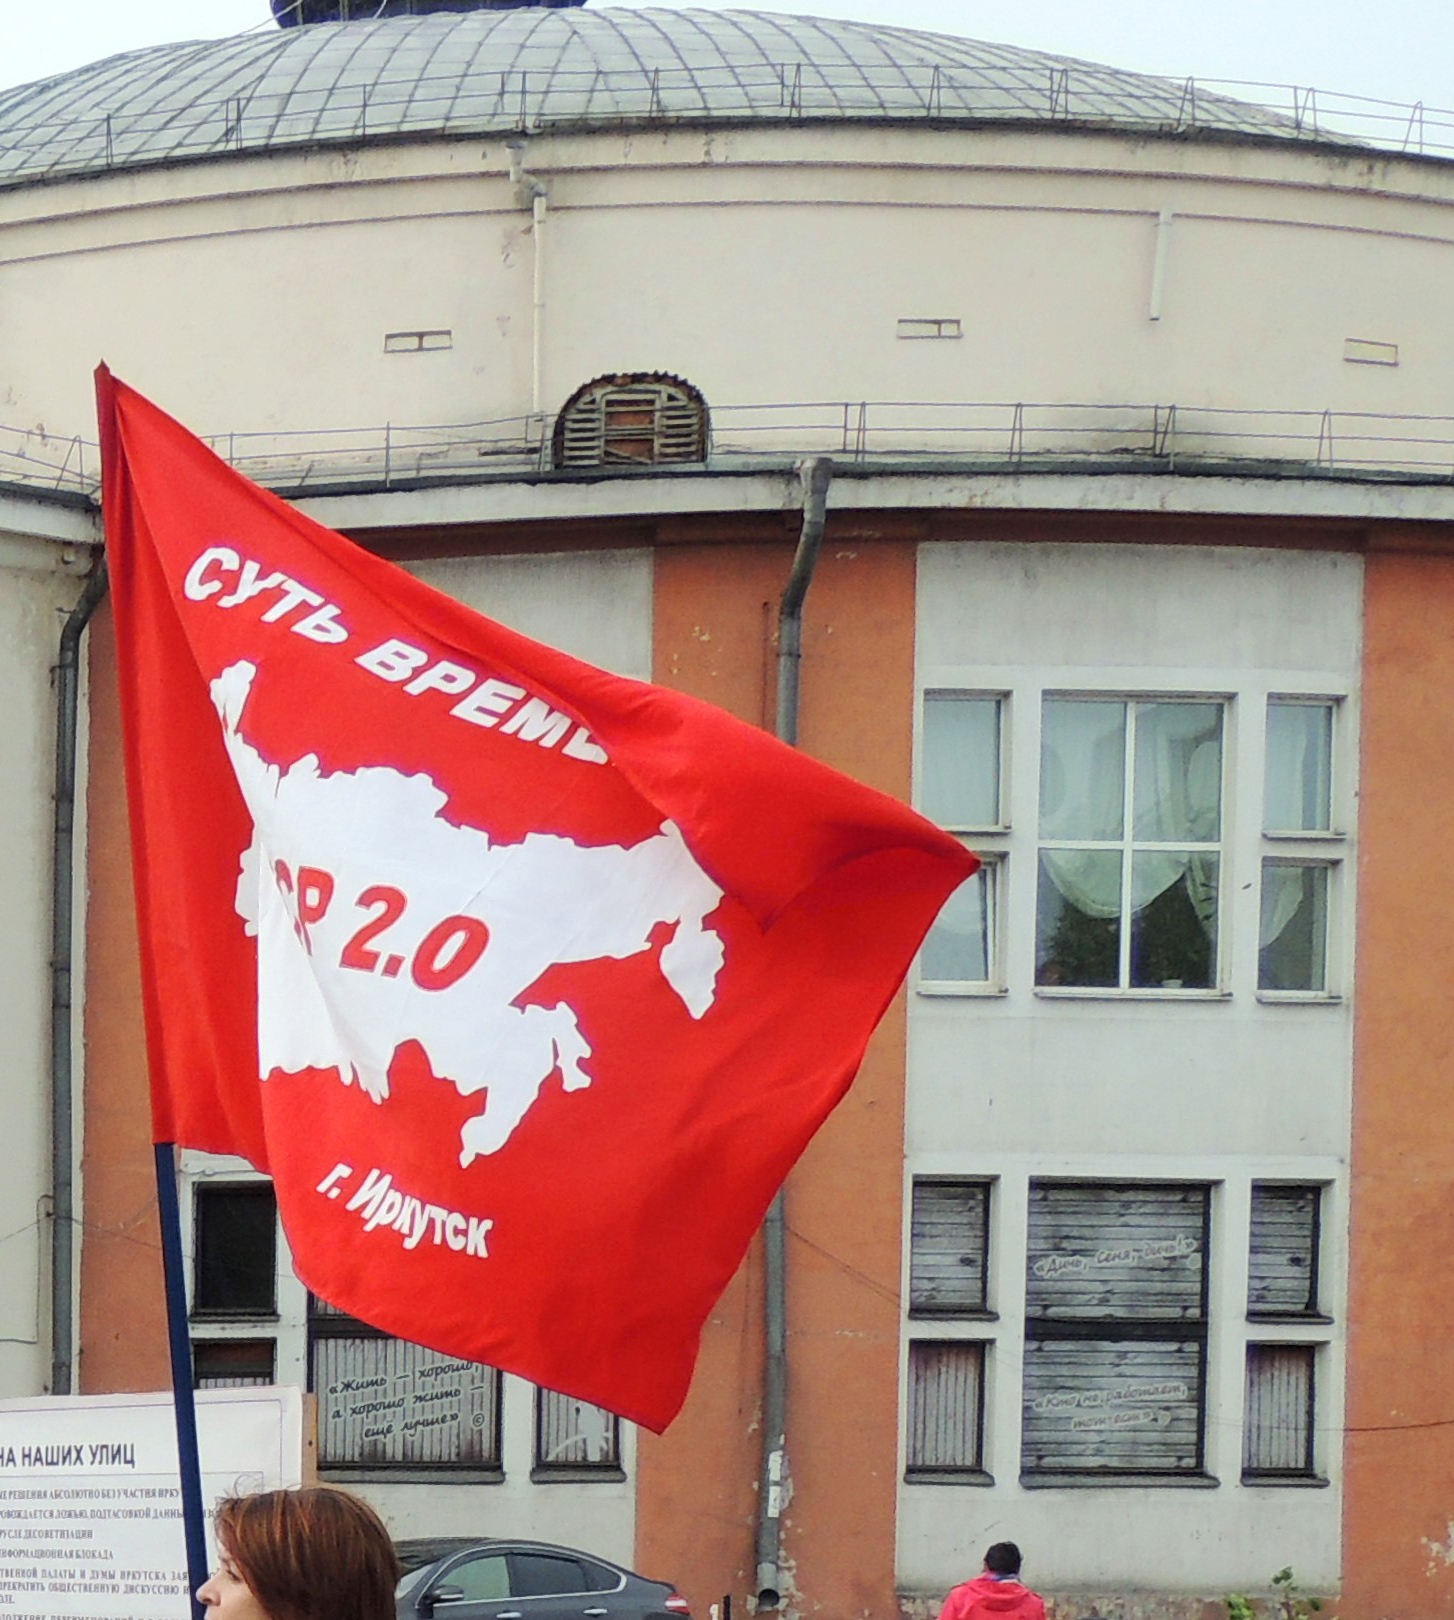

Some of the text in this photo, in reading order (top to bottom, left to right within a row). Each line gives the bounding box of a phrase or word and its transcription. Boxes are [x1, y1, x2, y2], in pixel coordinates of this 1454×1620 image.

[184, 546, 350, 644] СУТЬ
[339, 884, 490, 992] 2.0
[315, 1163, 493, 1258] г. Иркутск
[349, 1397, 405, 1418] хорошо
[412, 1386, 461, 1405] жить
[364, 1423, 393, 1440] ещё
[21, 1444, 84, 1468] НАШИХ
[88, 1443, 136, 1468] УЛИЦ
